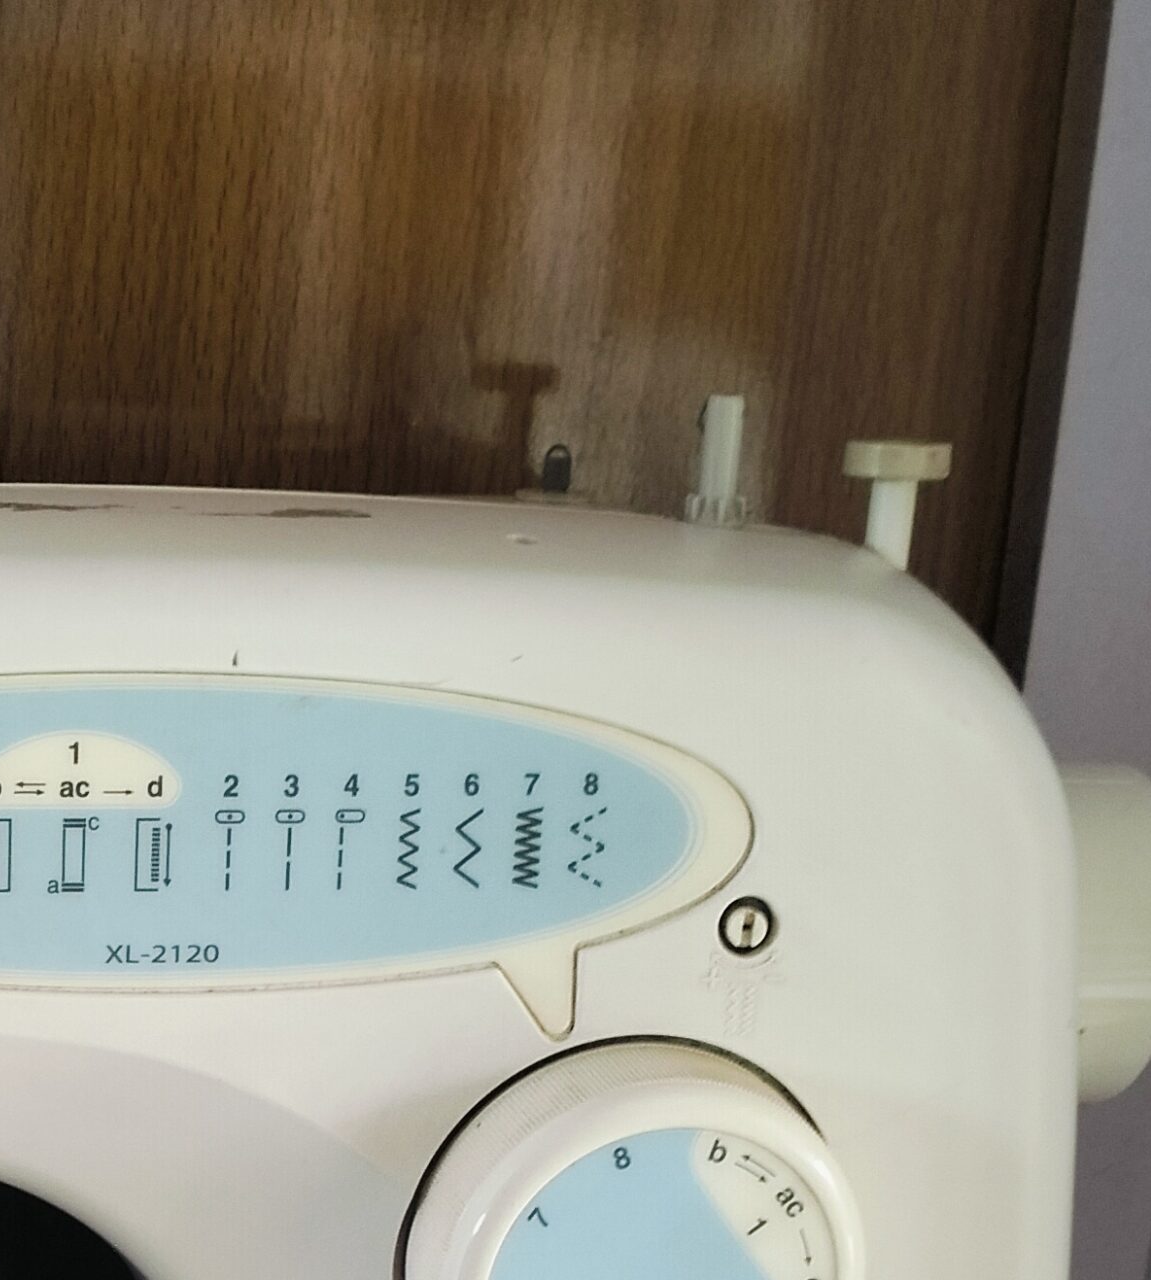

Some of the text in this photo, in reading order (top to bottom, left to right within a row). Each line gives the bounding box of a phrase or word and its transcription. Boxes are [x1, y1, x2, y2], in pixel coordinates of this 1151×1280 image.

[69, 742, 78, 764] 1
[60, 781, 89, 797] ac
[148, 776, 162, 797] d
[224, 773, 598, 797] 2 3 4 5 6 7 8
[89, 817, 99, 830] c
[48, 880, 59, 893] a
[106, 945, 219, 963] XL-2120
[614, 1147, 631, 1170] 8
[708, 1139, 727, 1163] b
[776, 1188, 804, 1218] ac
[527, 1207, 548, 1227] 7
[747, 1219, 767, 1236] 1
